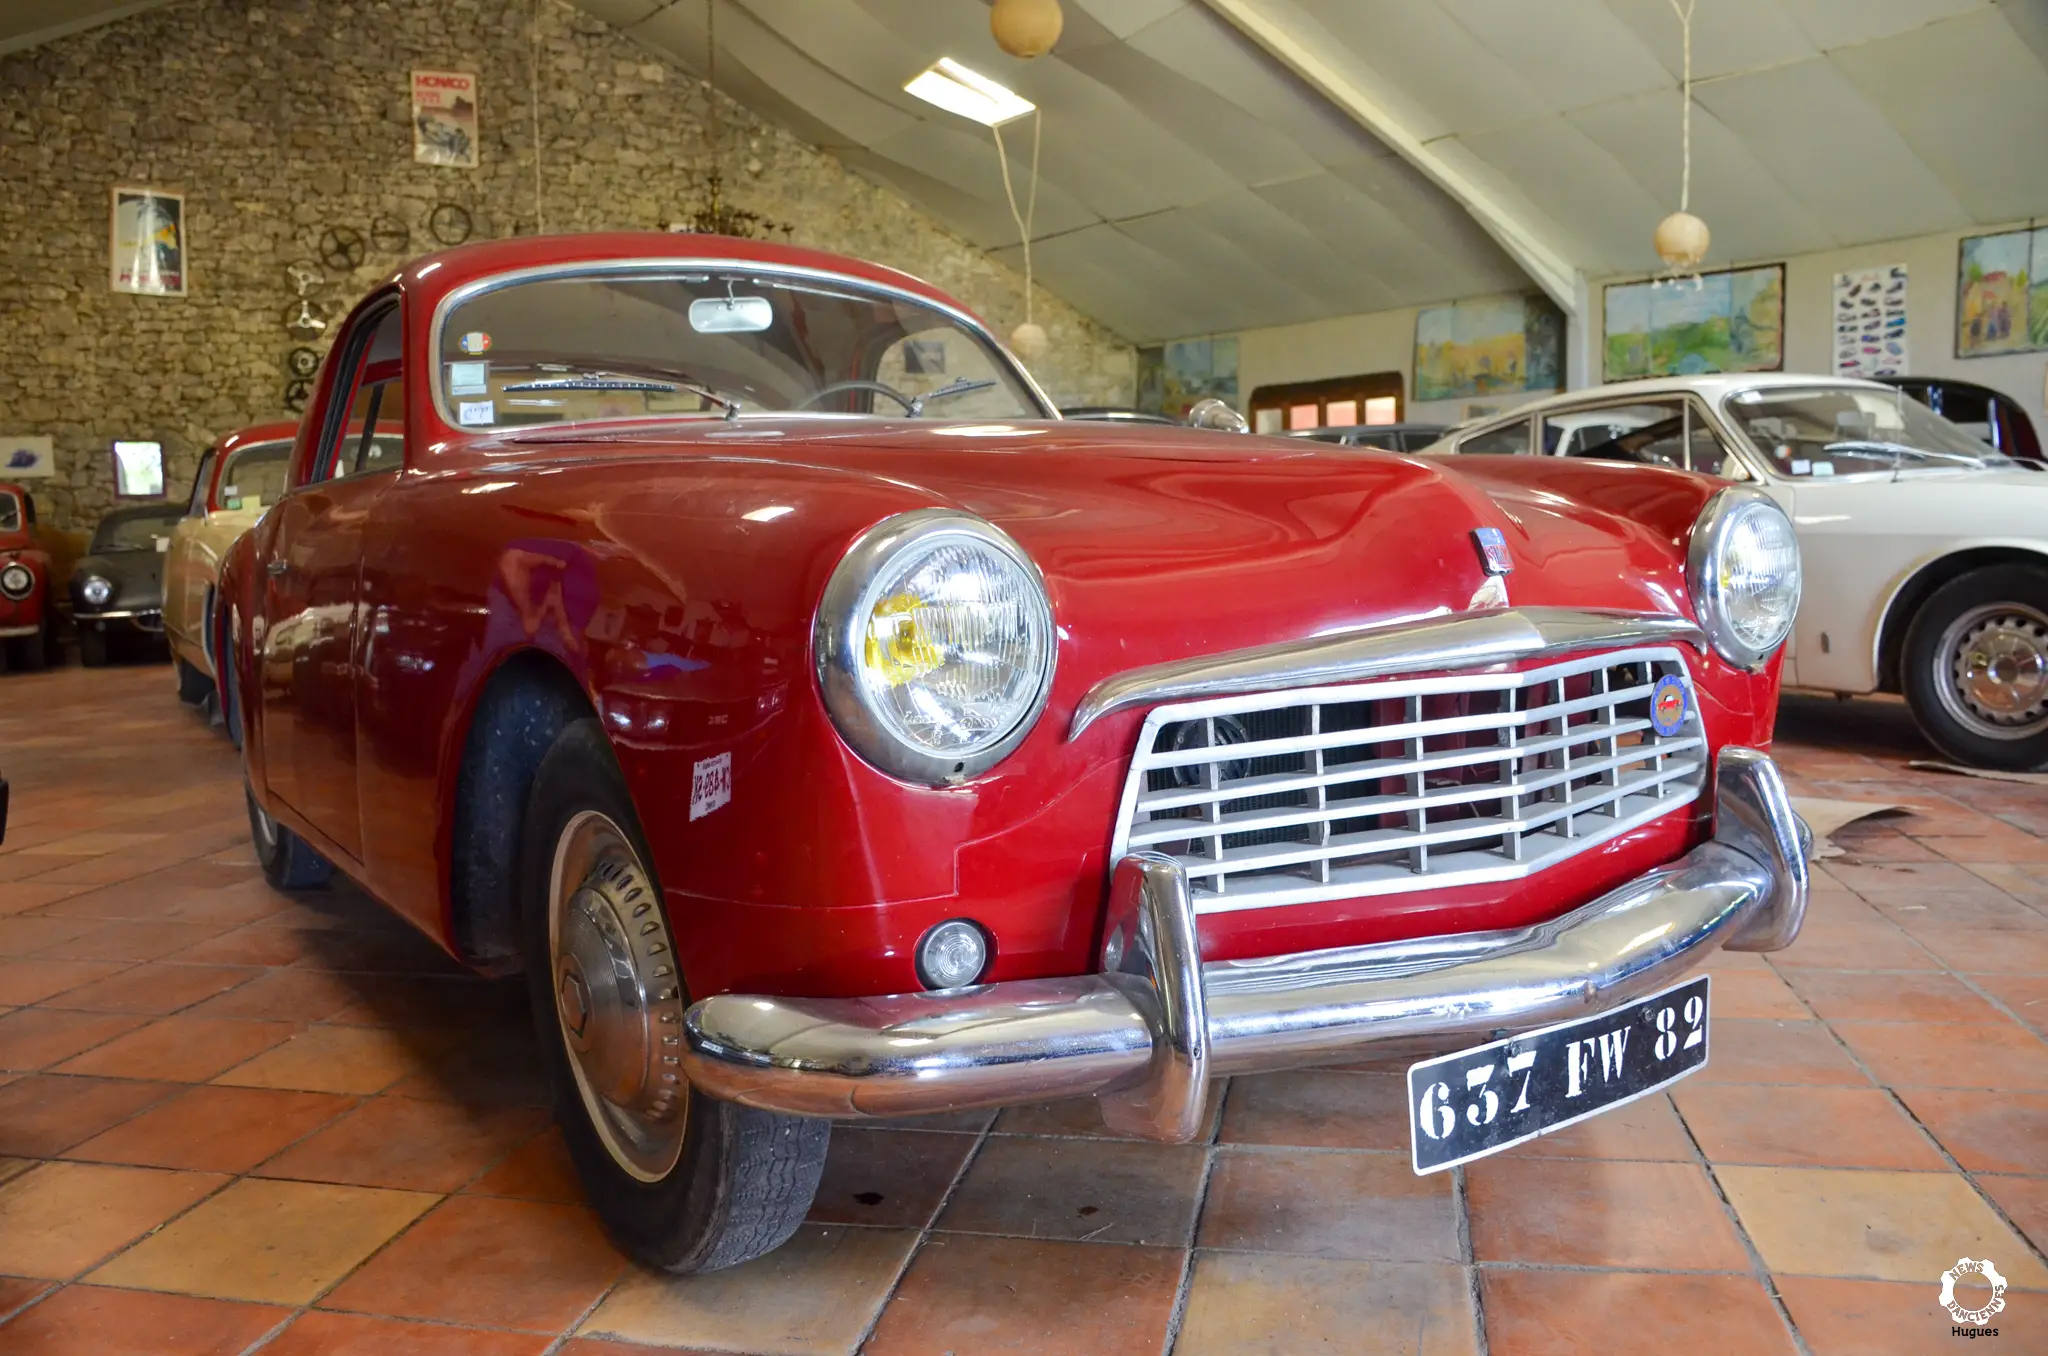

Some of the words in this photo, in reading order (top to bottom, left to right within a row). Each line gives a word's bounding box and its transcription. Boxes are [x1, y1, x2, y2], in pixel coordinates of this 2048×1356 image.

[415, 75, 470, 91] MONACO
[1419, 1050, 1536, 1140] 637
[1565, 1026, 1631, 1098] FW
[1654, 995, 1704, 1061] 82
